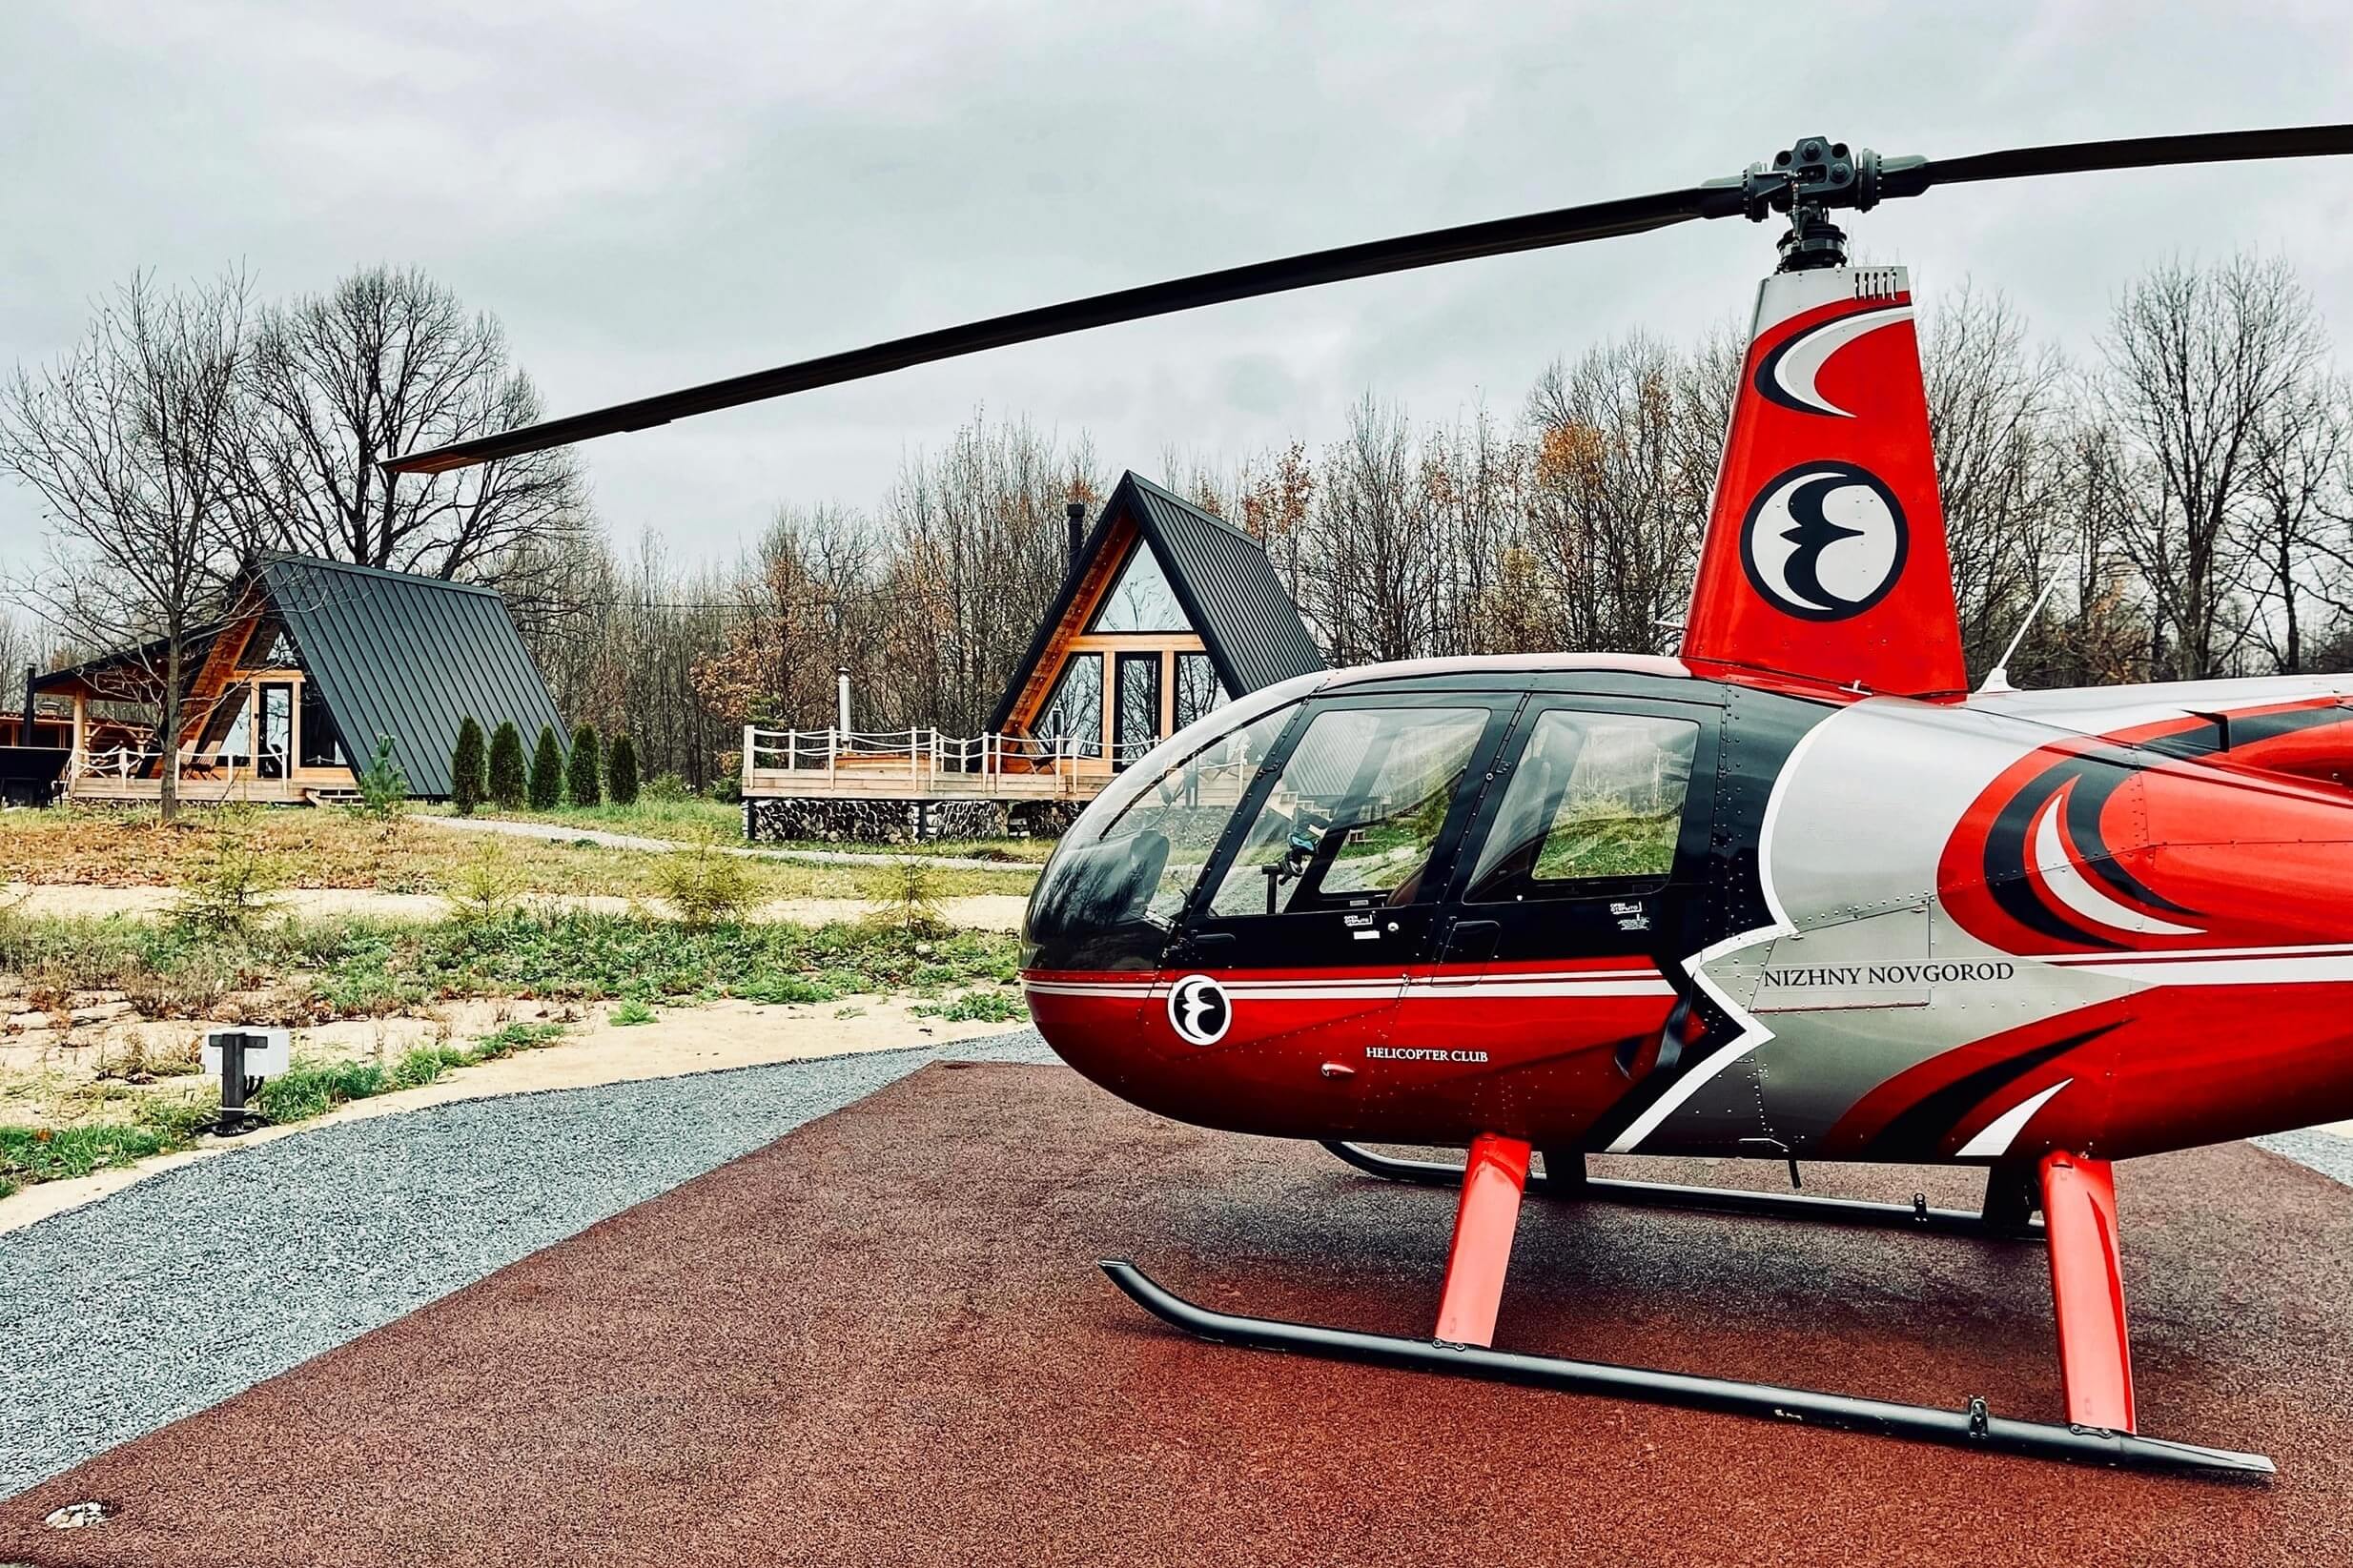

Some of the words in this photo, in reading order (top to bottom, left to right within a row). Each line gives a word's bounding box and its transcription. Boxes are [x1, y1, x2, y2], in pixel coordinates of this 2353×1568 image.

[1764, 967, 1862, 988] NIZHNY
[1868, 962, 2015, 985] NOVGOROD
[1365, 1047, 1450, 1062] HELICOPTER
[1451, 1049, 1489, 1063] CLUB
